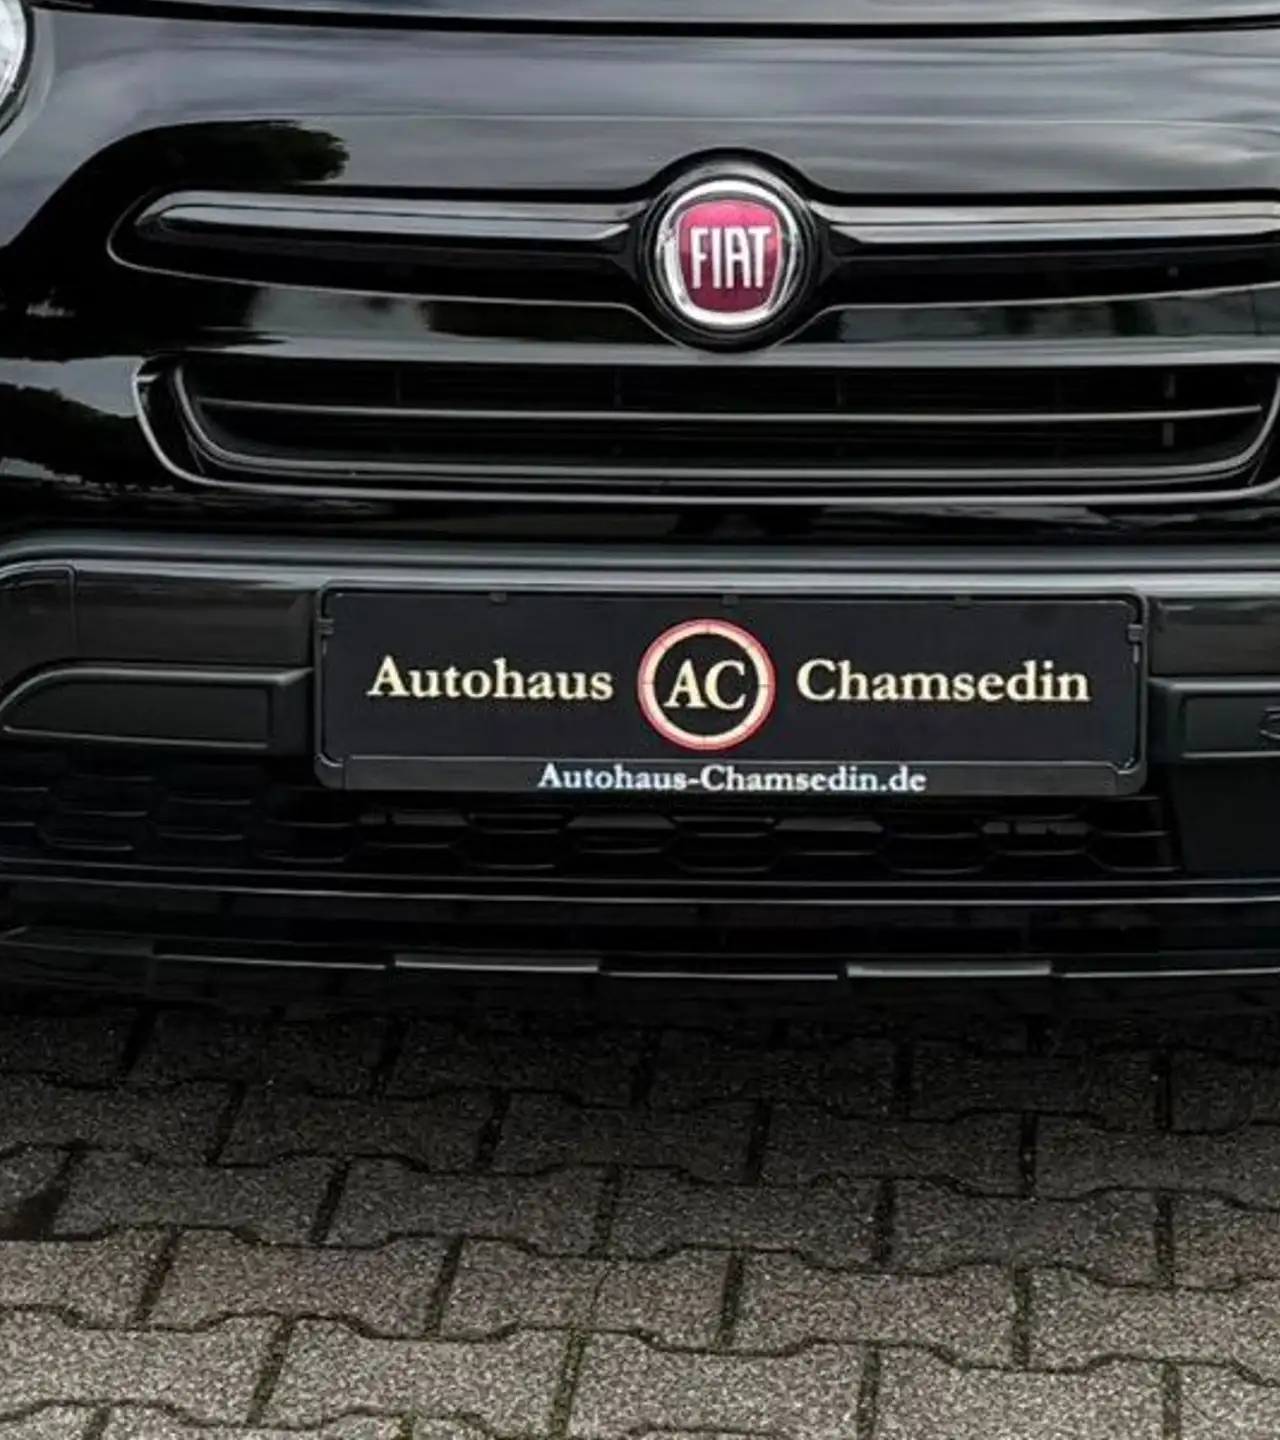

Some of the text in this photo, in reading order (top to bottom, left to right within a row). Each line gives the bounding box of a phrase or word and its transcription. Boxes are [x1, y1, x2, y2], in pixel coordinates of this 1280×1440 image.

[689, 224, 772, 290] FIAT
[366, 655, 1091, 711] Autohaus AC Chamsedin
[537, 760, 928, 794] Autohaus-Chamsedin.de
